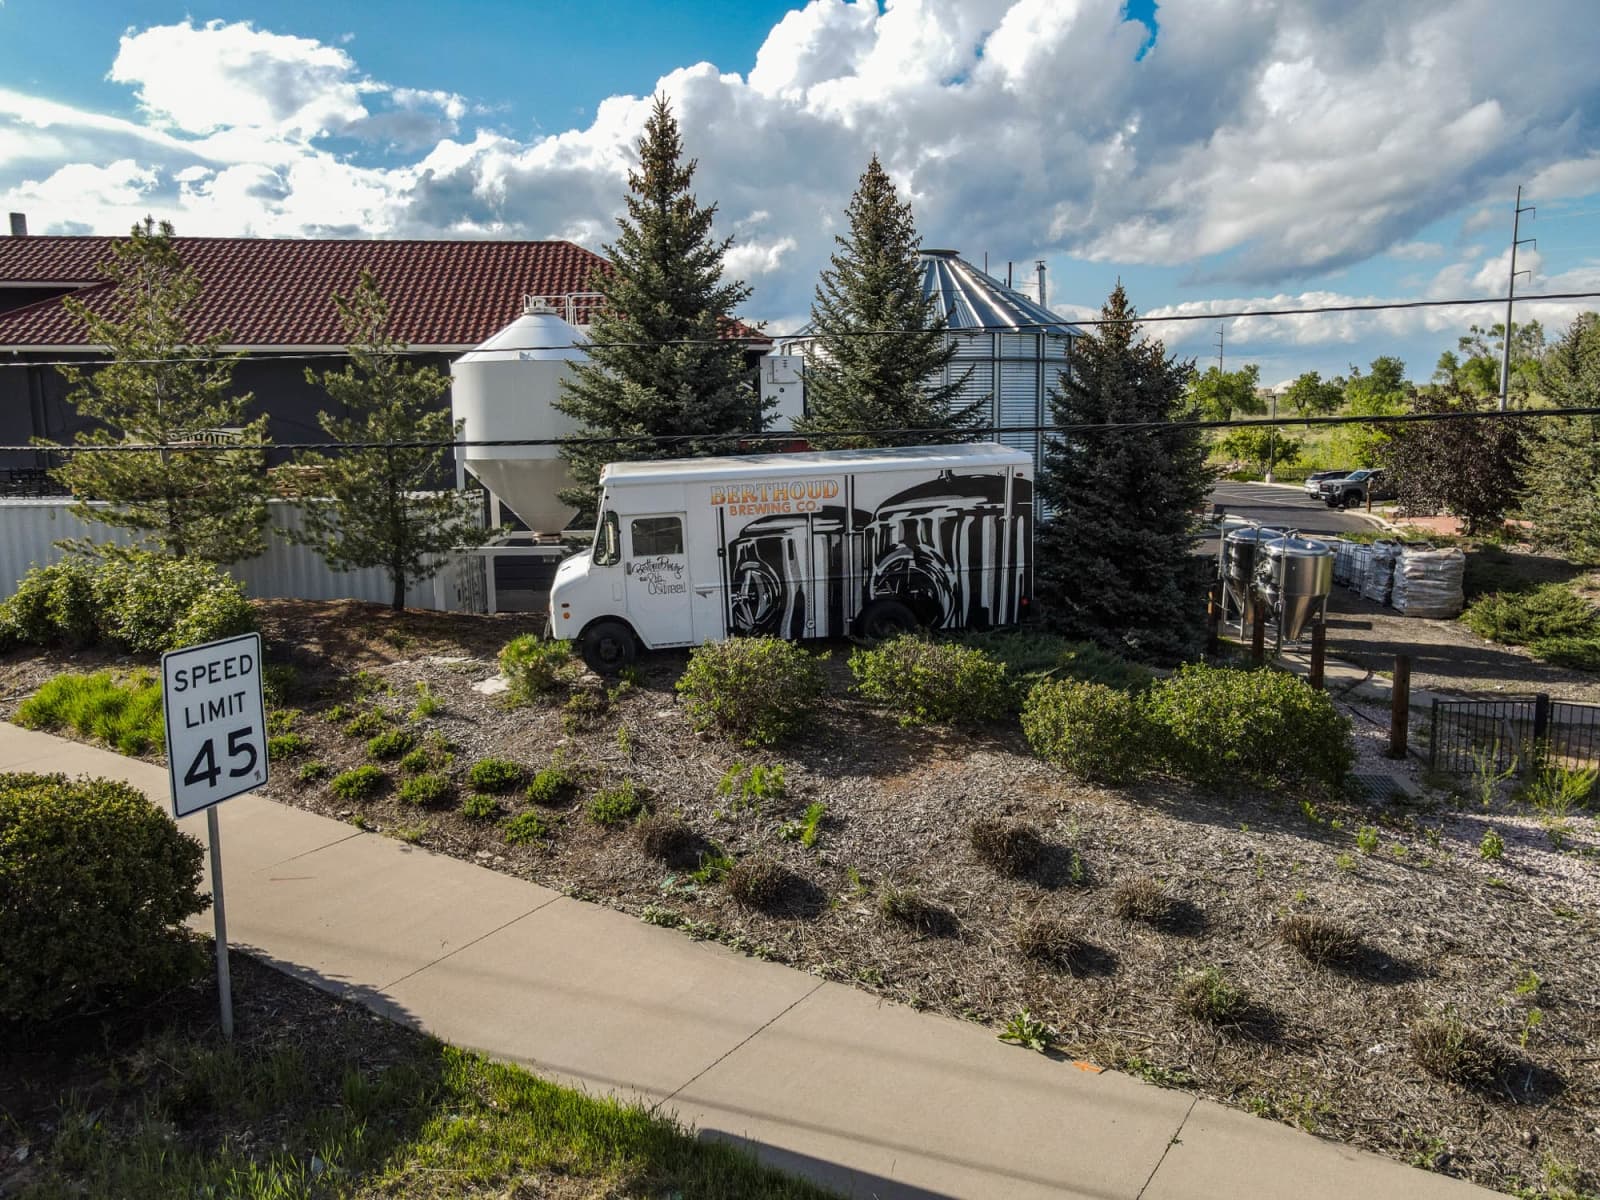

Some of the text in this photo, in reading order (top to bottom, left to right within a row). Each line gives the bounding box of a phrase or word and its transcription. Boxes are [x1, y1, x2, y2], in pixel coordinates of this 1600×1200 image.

[710, 480, 839, 505] BERTHOUD
[729, 500, 821, 516] BREWING CO.
[174, 654, 253, 692] SPEED
[185, 691, 246, 729] LIMIT
[184, 726, 258, 788] 45
